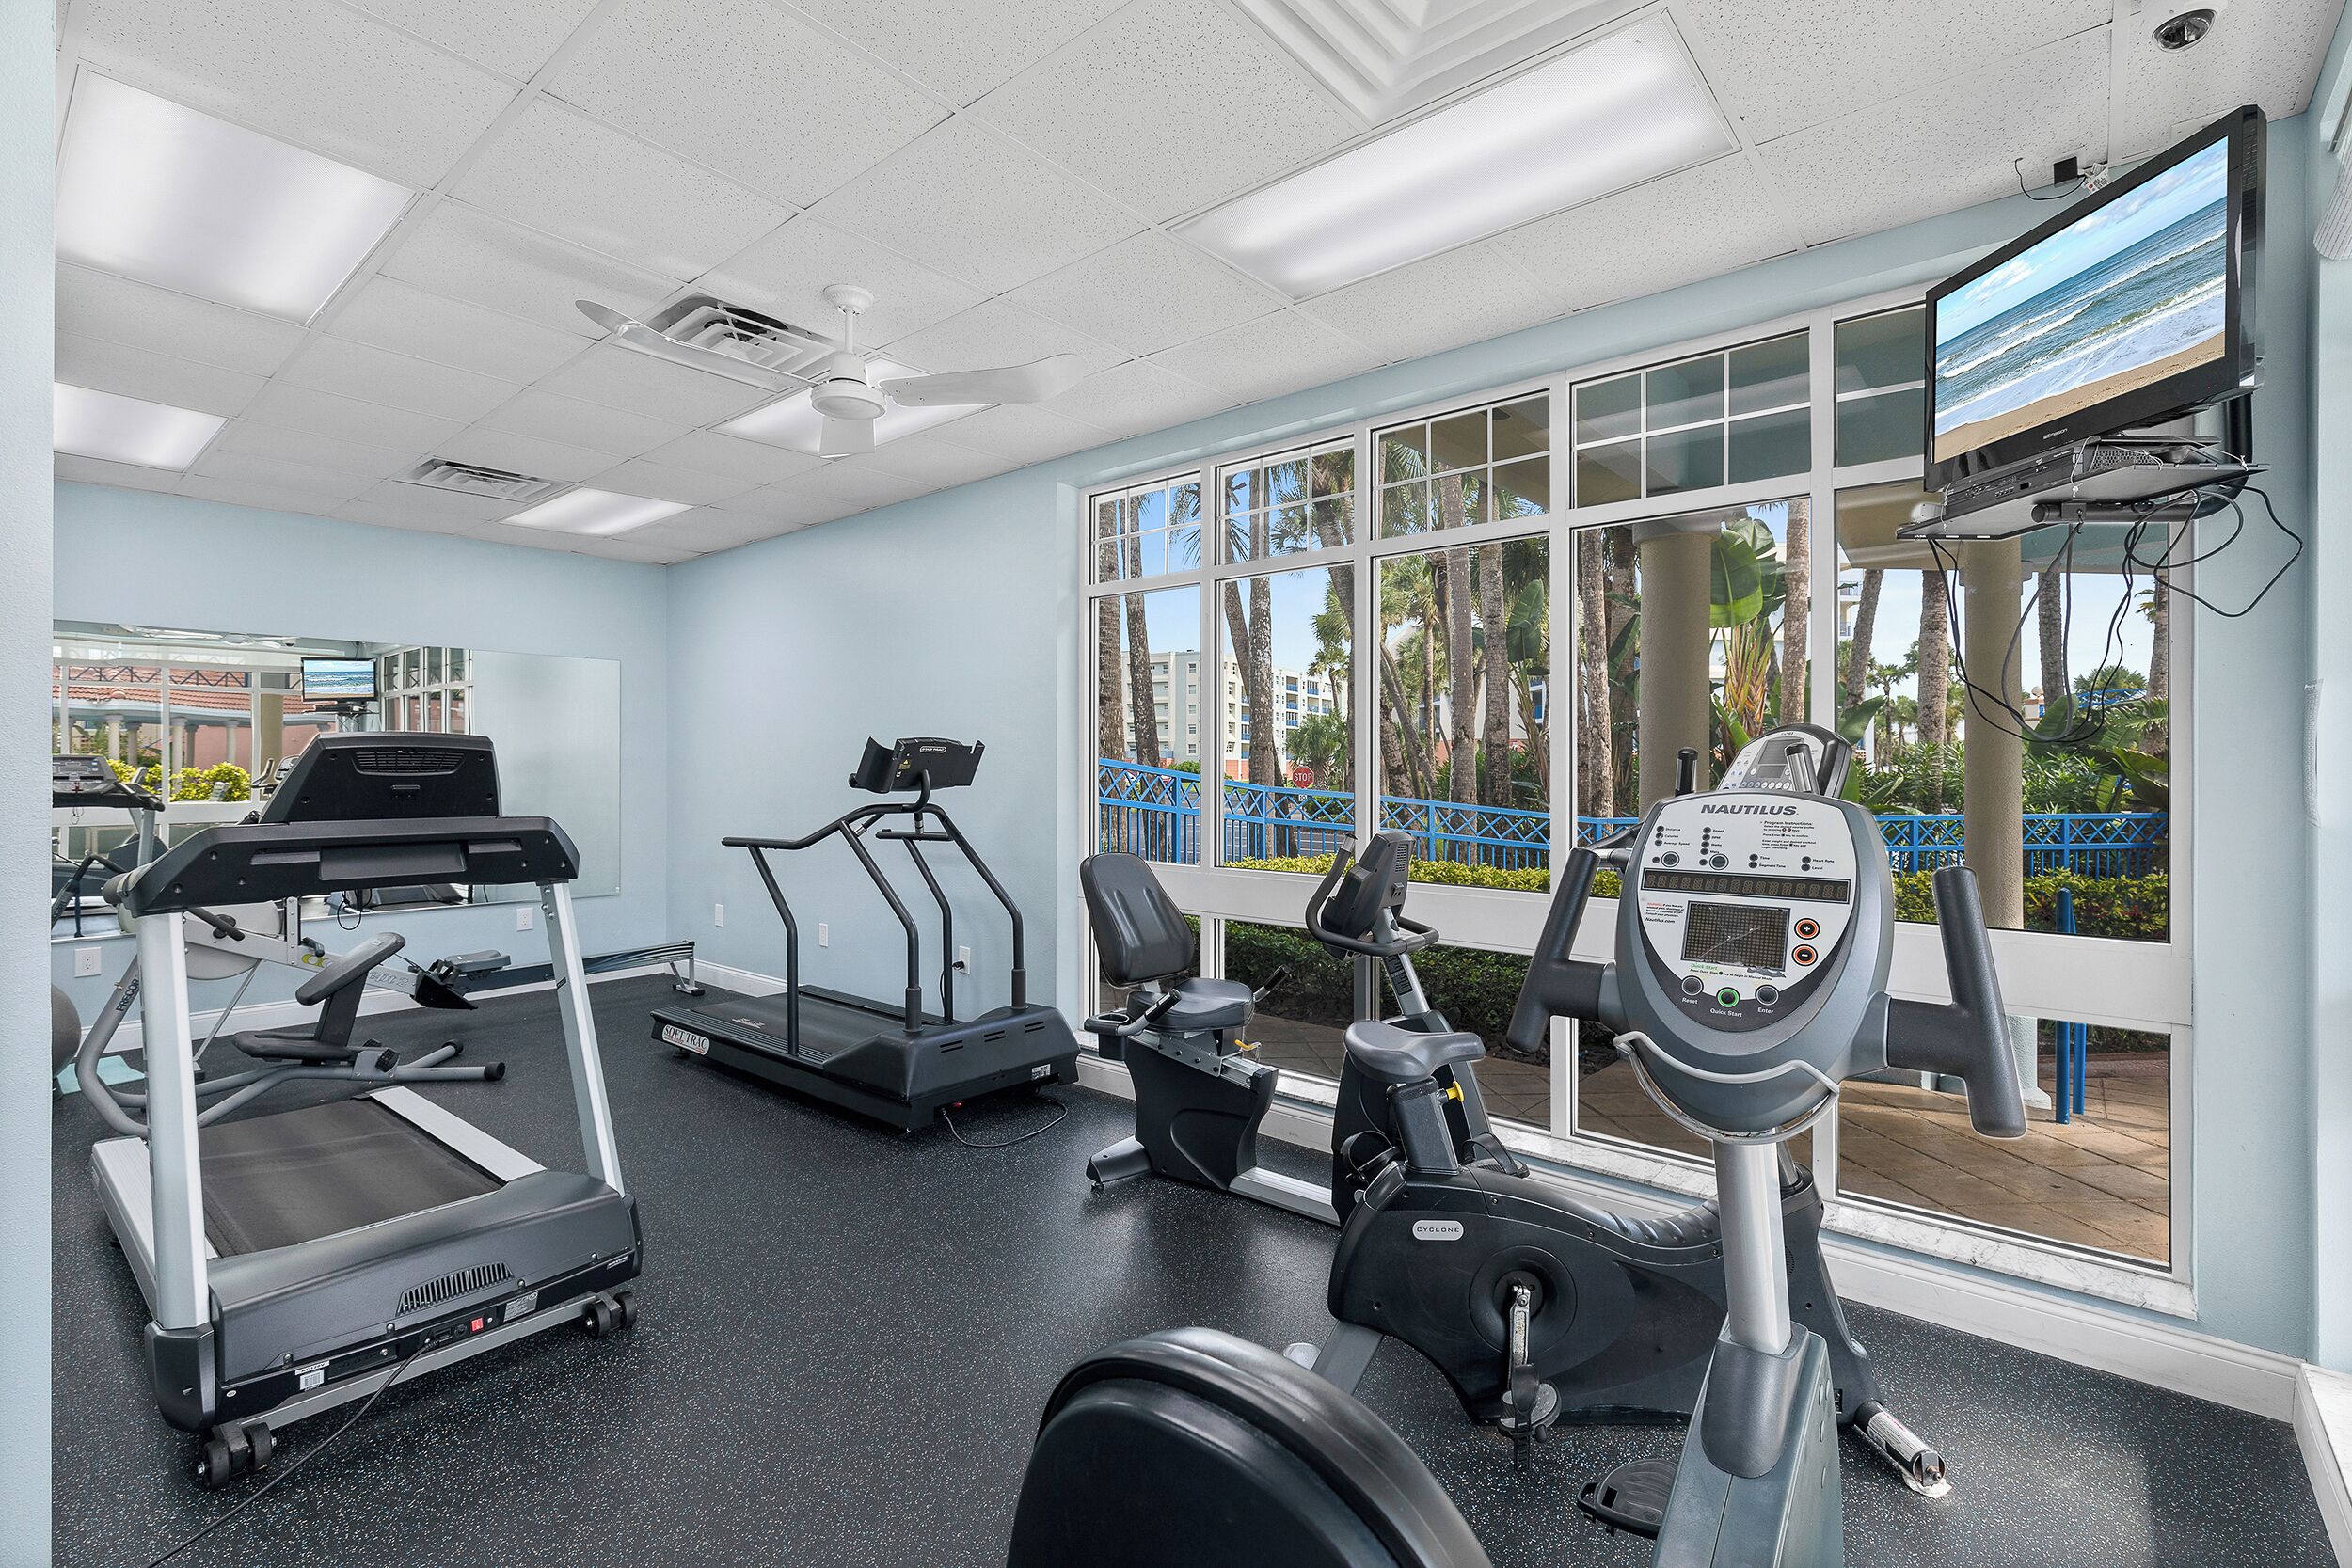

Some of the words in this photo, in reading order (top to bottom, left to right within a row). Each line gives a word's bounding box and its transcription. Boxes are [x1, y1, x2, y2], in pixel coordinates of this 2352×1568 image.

[1294, 772, 1312, 782] STOP
[1700, 804, 1798, 816] NAUTILUS
[116, 978, 139, 1011] PRECOR
[664, 1025, 685, 1040] SOFT
[686, 1032, 707, 1050] TRAC
